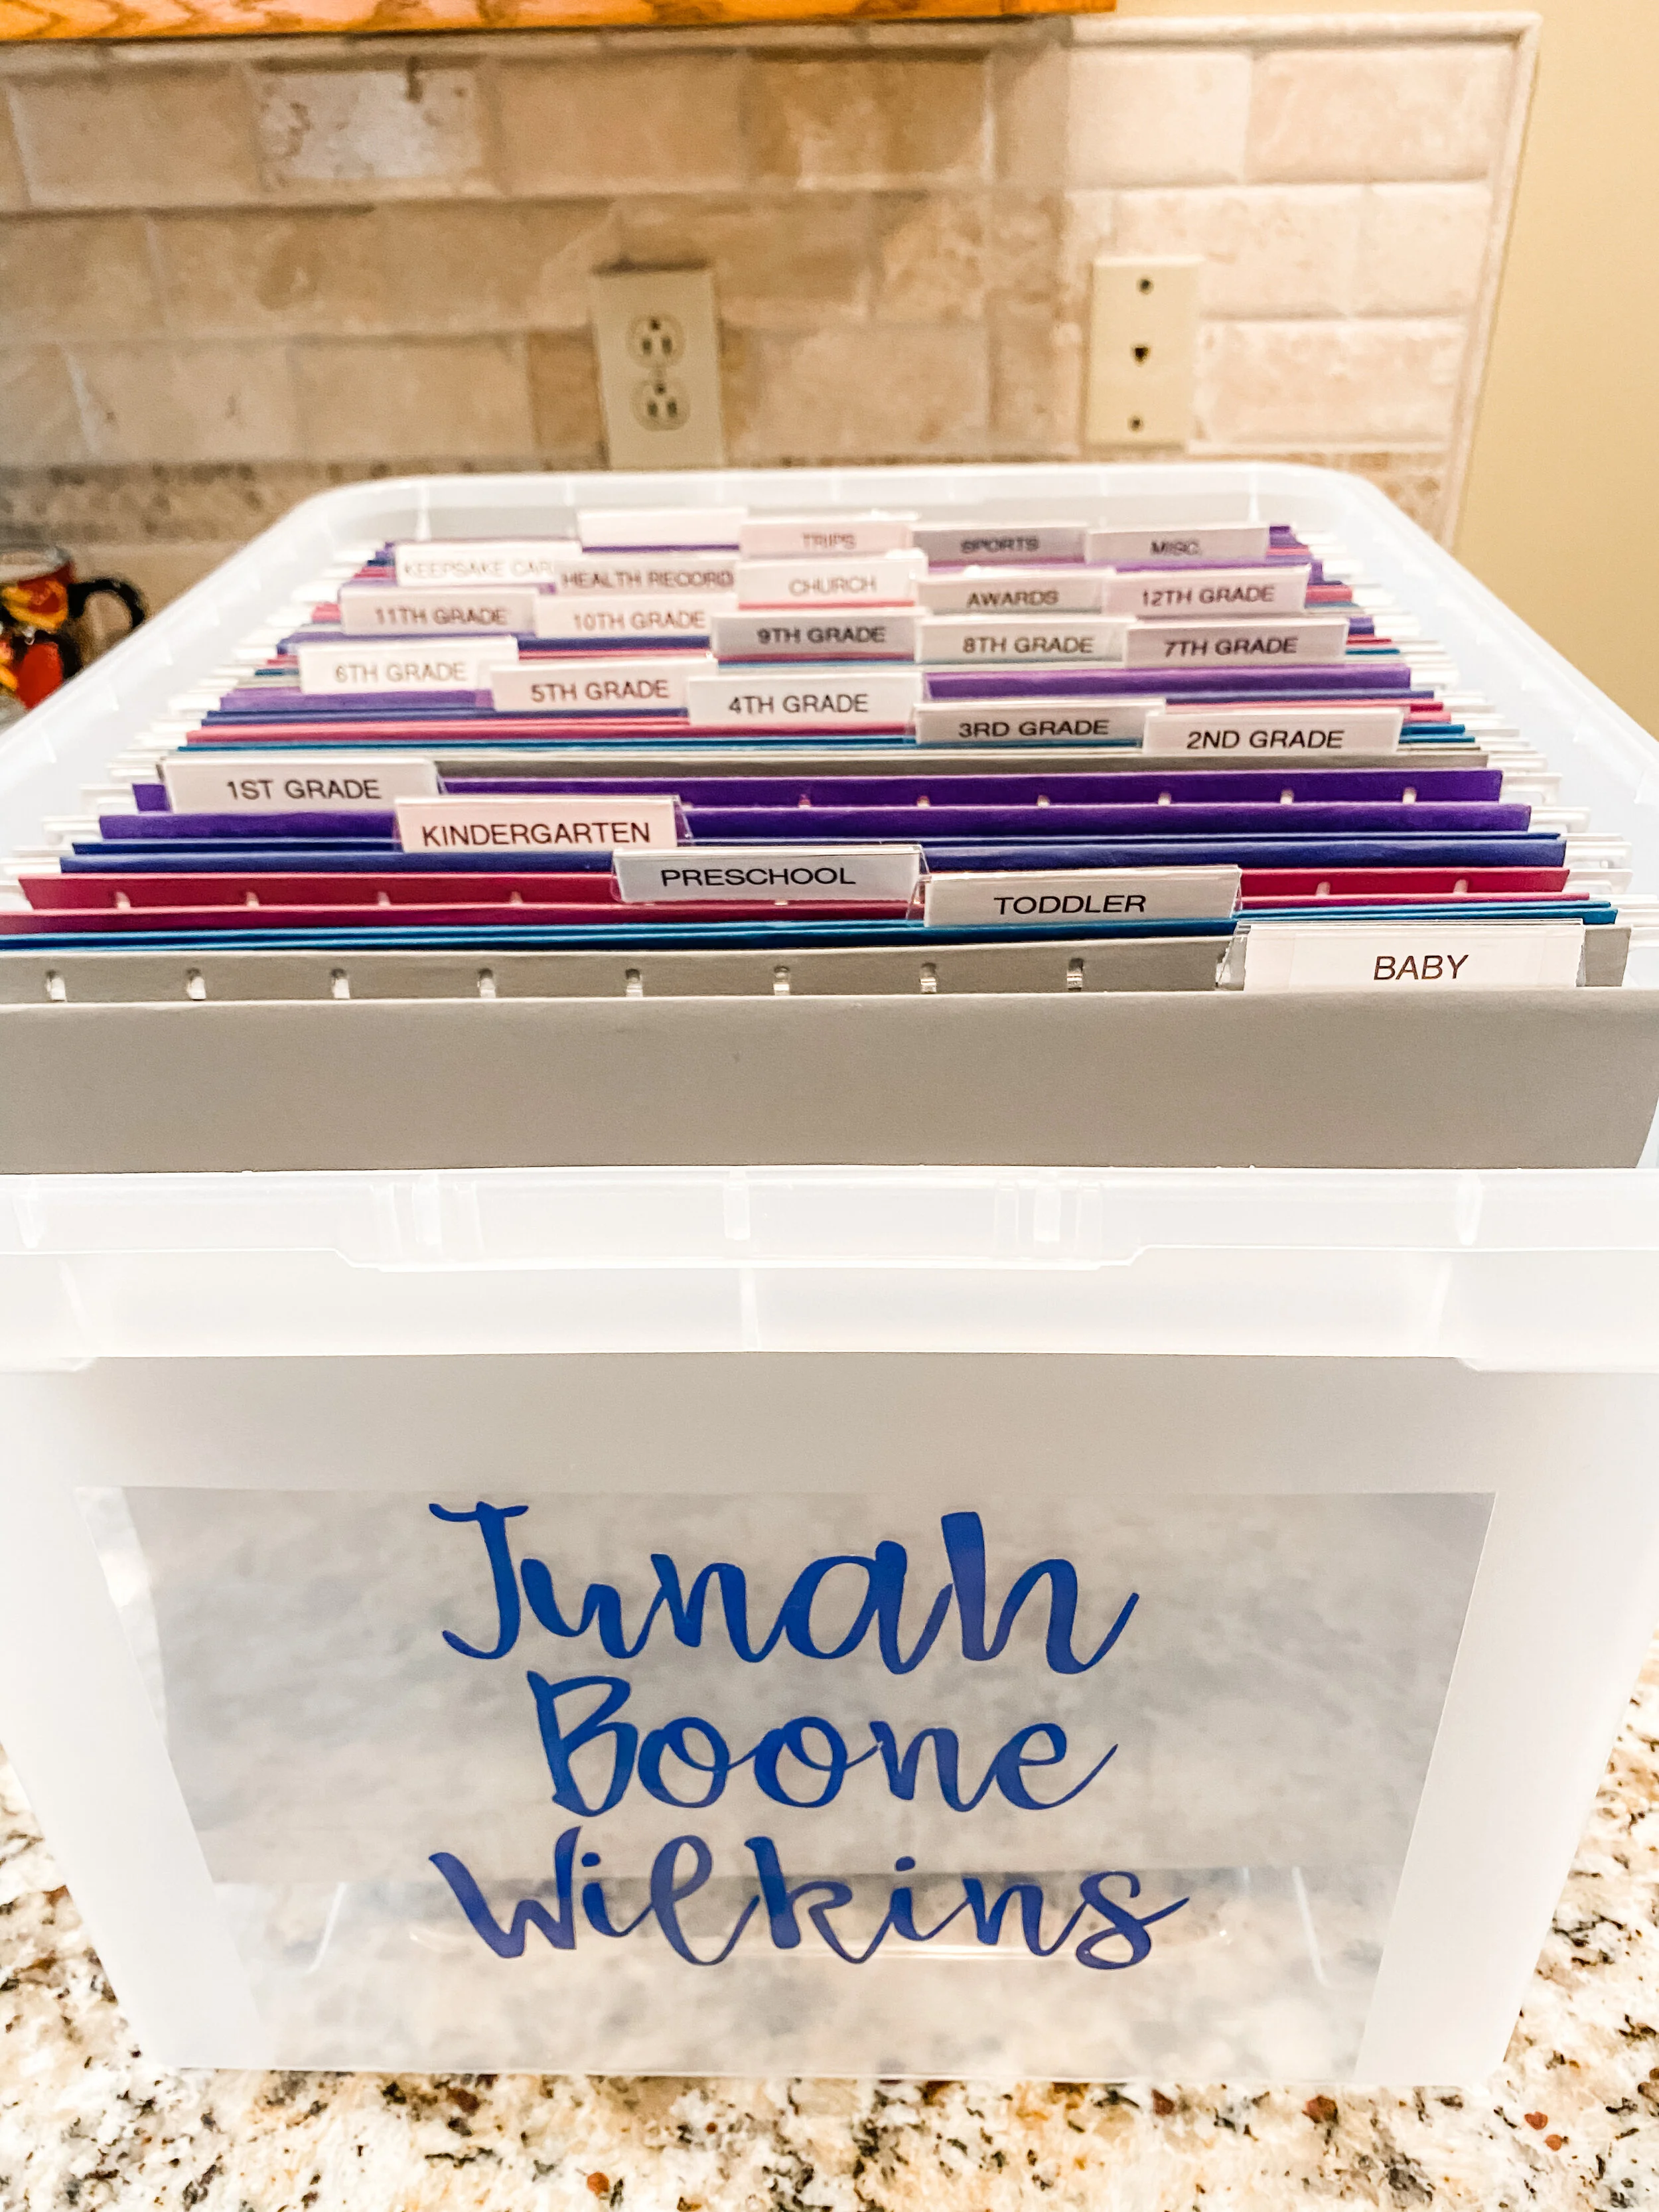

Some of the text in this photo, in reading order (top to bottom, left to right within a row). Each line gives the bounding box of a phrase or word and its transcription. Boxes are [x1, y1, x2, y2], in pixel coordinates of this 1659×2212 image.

[803, 531, 857, 550] TRIPS
[961, 535, 1040, 554] SPORTS
[561, 569, 642, 589] HEALTH
[788, 574, 877, 597] CHURCH
[966, 589, 1060, 609] AWARDS
[1141, 583, 1275, 607] 12TH GRADE
[375, 605, 510, 626] 11TH GRADE
[573, 608, 706, 631] 10TH GRADE
[756, 625, 887, 644] 9TH GRADE
[962, 635, 1094, 654] 8TH GRADE
[1164, 636, 1299, 658] 7TH GRADE
[334, 660, 468, 684] 6TH GRADE
[530, 678, 670, 703] 5TH GRADE
[728, 692, 871, 715] 4TH GRADE
[958, 718, 1110, 739] 3RD GRADE
[1186, 729, 1346, 751] 2ND GRADE
[226, 778, 382, 800] 1ST GRADE
[421, 820, 652, 848] KINDERGARTEN
[661, 865, 857, 888] PRESCHOOL
[993, 893, 1147, 915] TODDLER
[1372, 954, 1470, 981] BABY
[429, 1501, 1140, 1675] Junah
[526, 1670, 1118, 1817] Boone
[428, 1826, 1190, 1971] Wilkins
